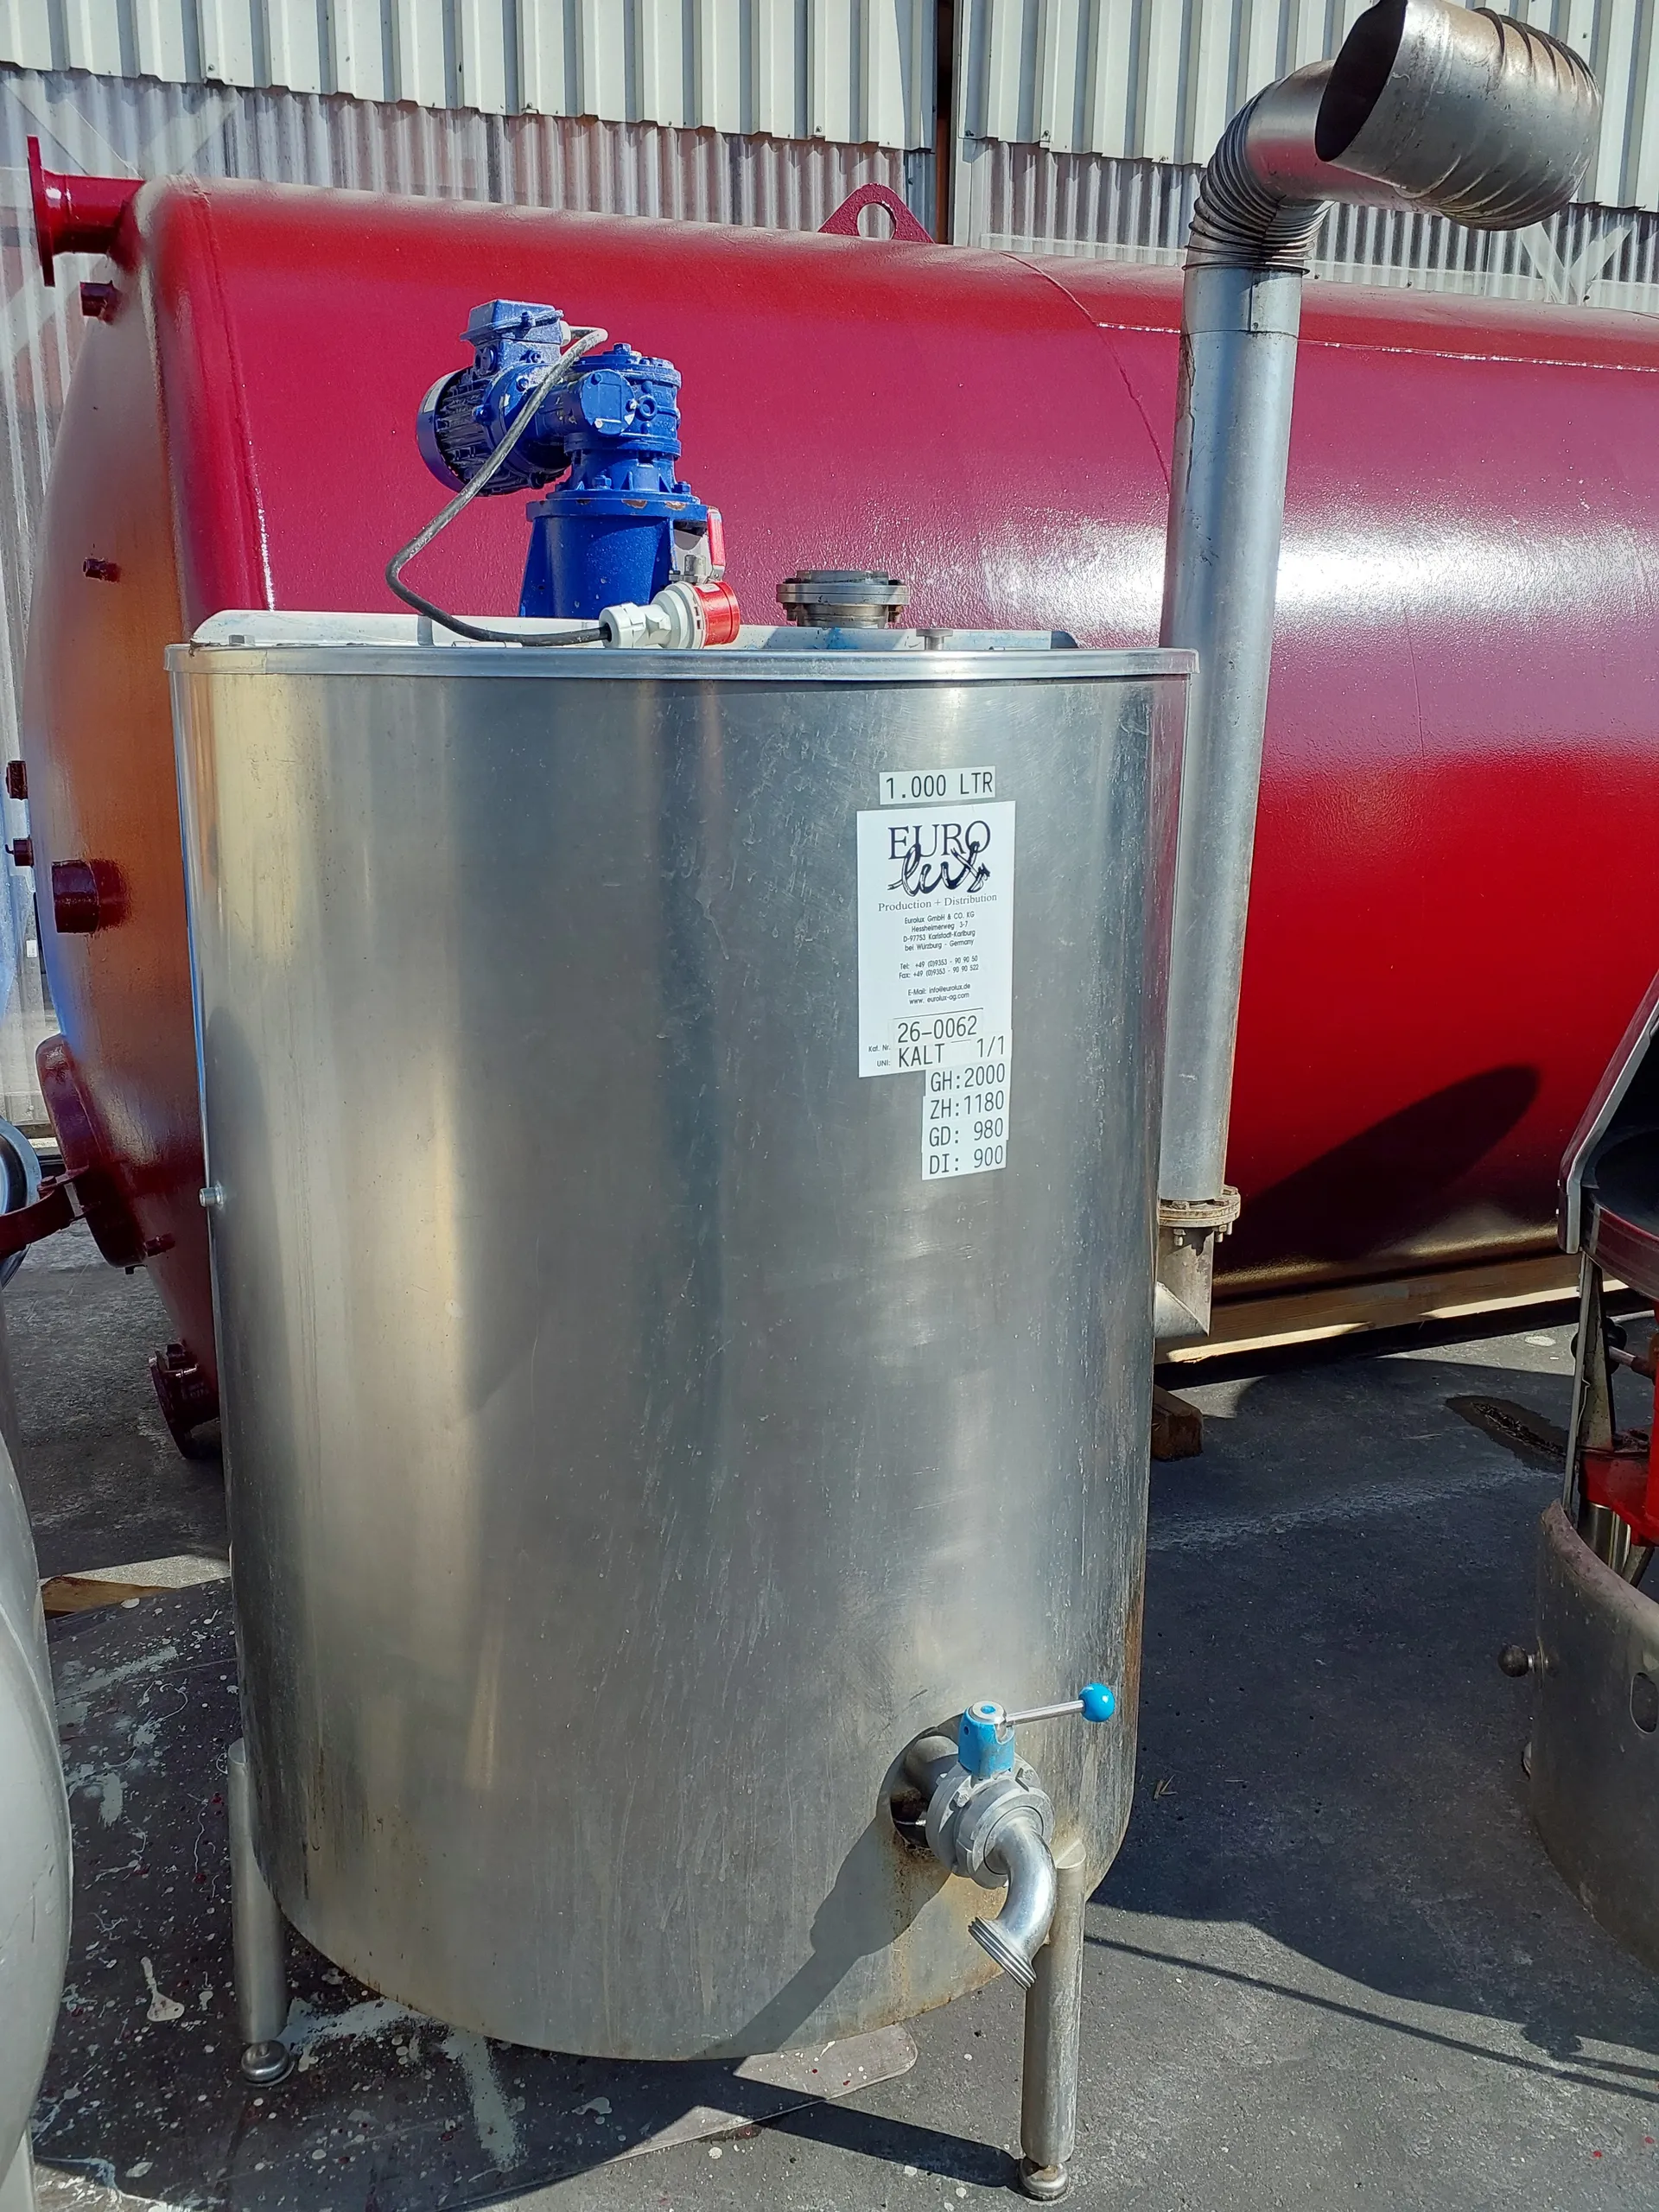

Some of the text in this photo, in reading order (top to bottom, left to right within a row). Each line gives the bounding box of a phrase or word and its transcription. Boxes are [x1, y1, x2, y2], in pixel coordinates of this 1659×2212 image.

[887, 772, 994, 798] 1.000 LTR
[888, 820, 991, 860] EURO
[878, 900, 931, 912] Production
[944, 894, 997, 907] Distribution
[903, 930, 976, 942] D-97753 Karlstadt-Karlburg
[911, 923, 954, 932] Hessheimerweg
[926, 968, 945, 976] (0)9353
[928, 958, 947, 968] (0)9353
[926, 992, 969, 1002] eurolux-ag.com
[929, 983, 971, 994] info@eurolux.de
[897, 1014, 977, 1044] 26-0062
[899, 1043, 945, 1068] KALT
[976, 1035, 1004, 1058] 1/1
[931, 1063, 1005, 1092] GH:2000
[930, 1090, 1004, 1120] ZH:1180
[930, 1117, 1003, 1147] GD: 980
[930, 1145, 1003, 1175] DI: 900
